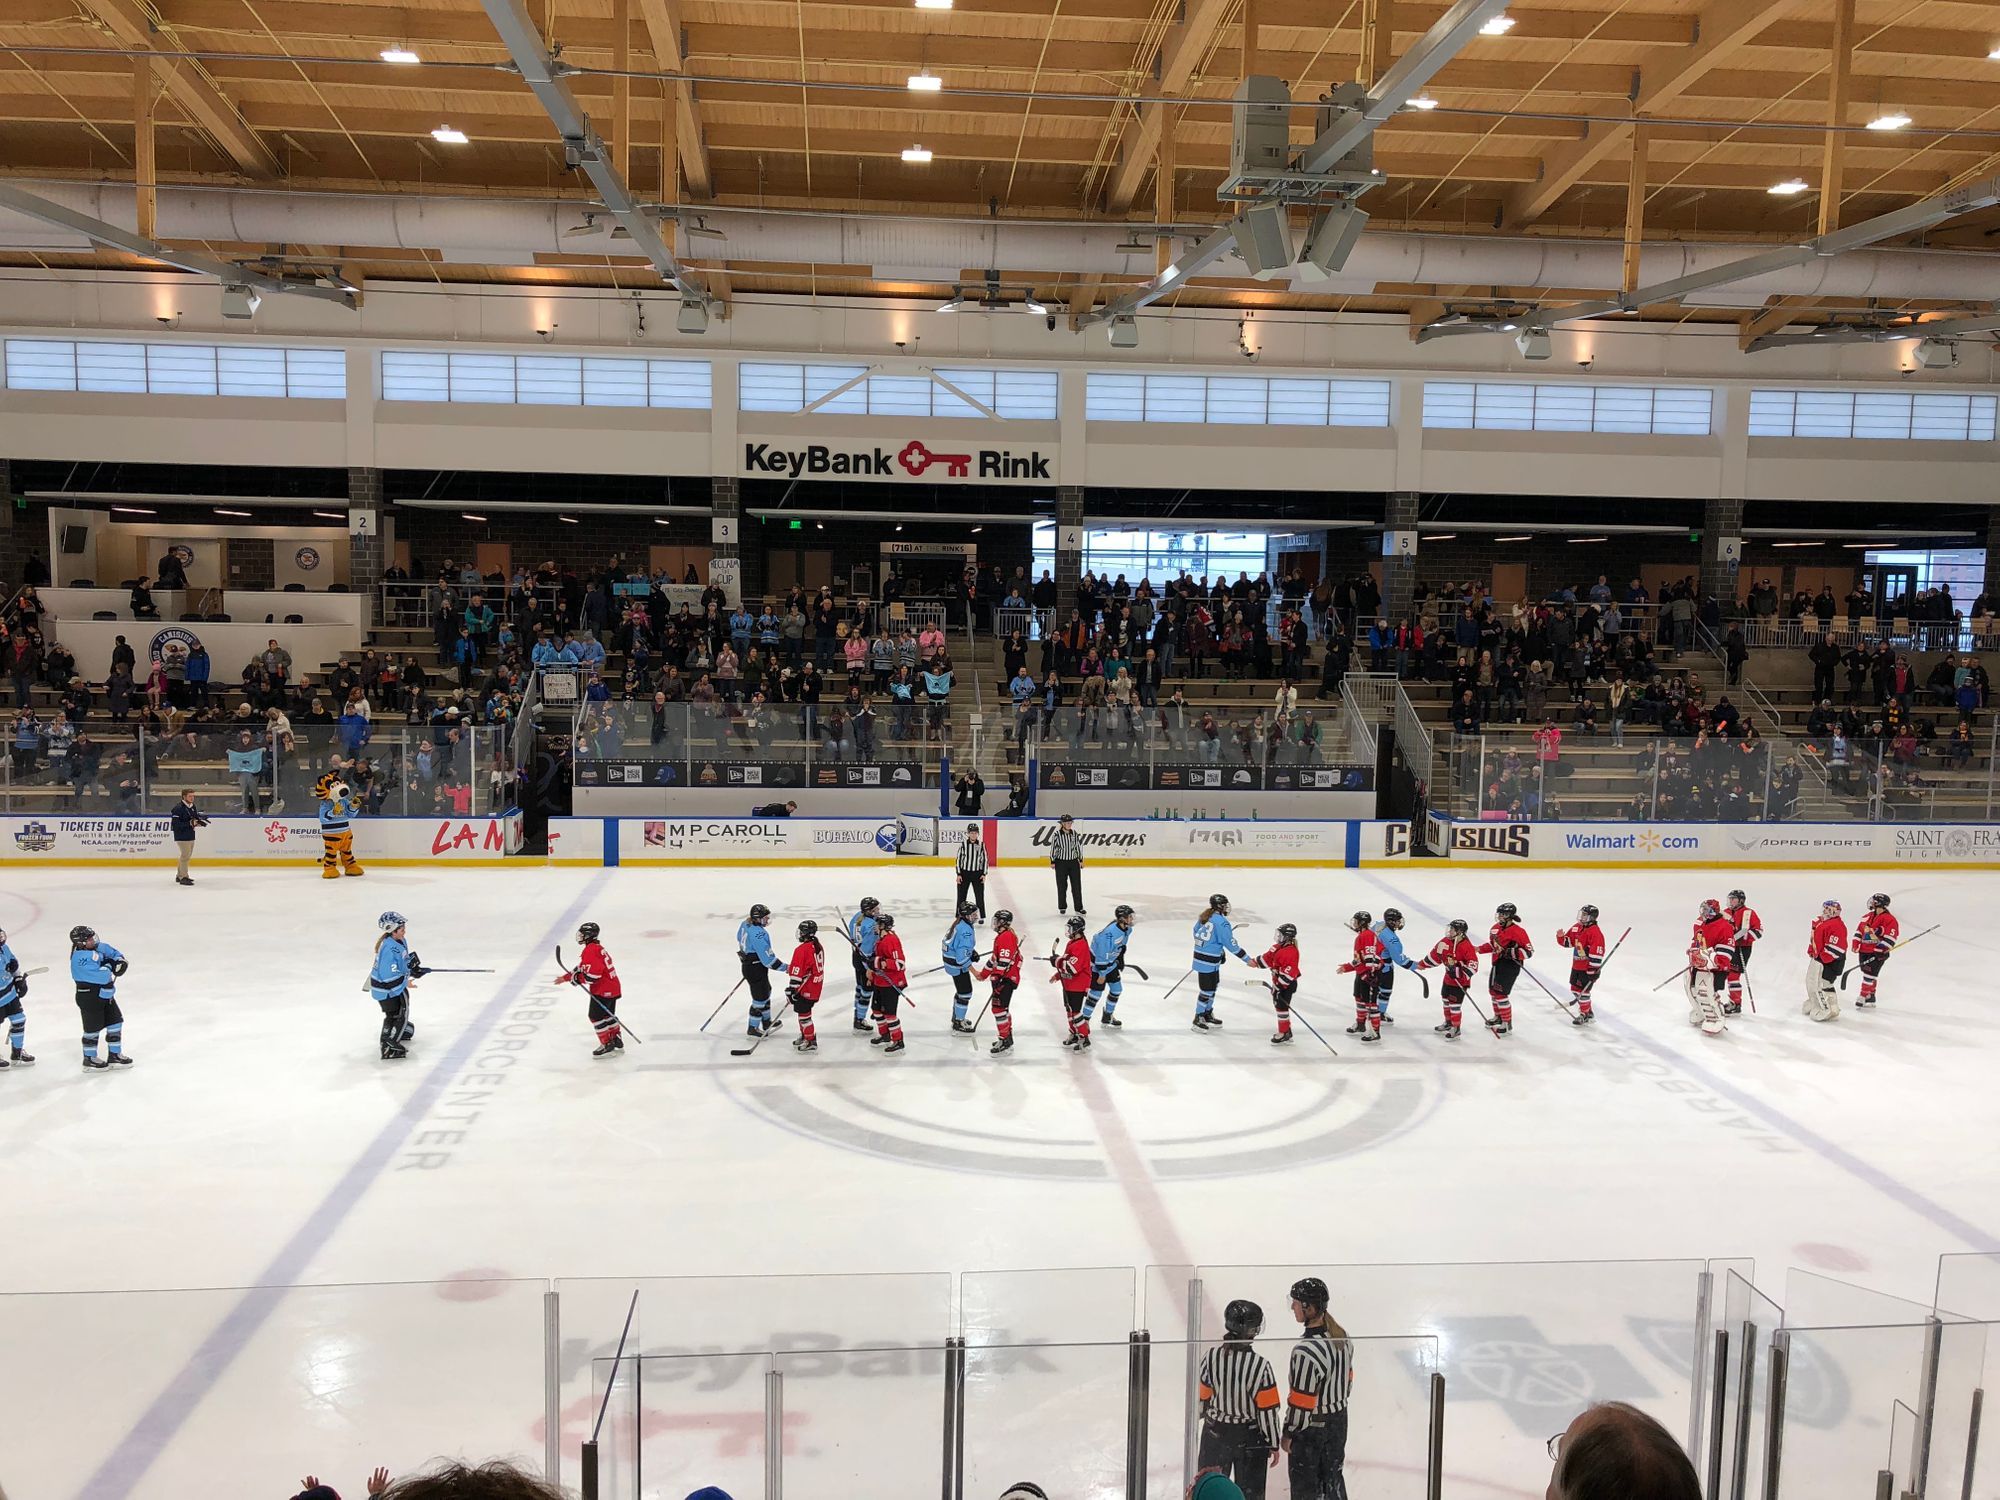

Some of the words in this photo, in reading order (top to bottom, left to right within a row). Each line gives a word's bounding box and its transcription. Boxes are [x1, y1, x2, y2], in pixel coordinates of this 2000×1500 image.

[745, 443, 893, 478] KeyBank
[979, 450, 1050, 478] Rink
[359, 517, 367, 528] 2
[721, 525, 729, 536] 3
[1067, 532, 1075, 543] 4
[1402, 538, 1408, 548] 5
[891, 543, 912, 552] (716)
[1726, 543, 1733, 554] 6
[717, 574, 734, 584] CUP
[158, 630, 194, 644] CANISIUS
[60, 821, 104, 832] TICKETS
[107, 821, 122, 832] ON
[125, 821, 151, 832] SALE
[154, 821, 173, 832] NO
[670, 824, 685, 836] M
[691, 824, 703, 836] P
[706, 824, 787, 837] CAROLL
[813, 829, 874, 844] BUFFALO
[1566, 833, 1636, 849] Walmart
[1662, 837, 1699, 849] com
[1759, 837, 1810, 847] ADPRO
[1896, 830, 1944, 846] SAINT
[999, 948, 1011, 957] 26
[1468, 960, 1478, 969] 25
[792, 966, 800, 975] 19
